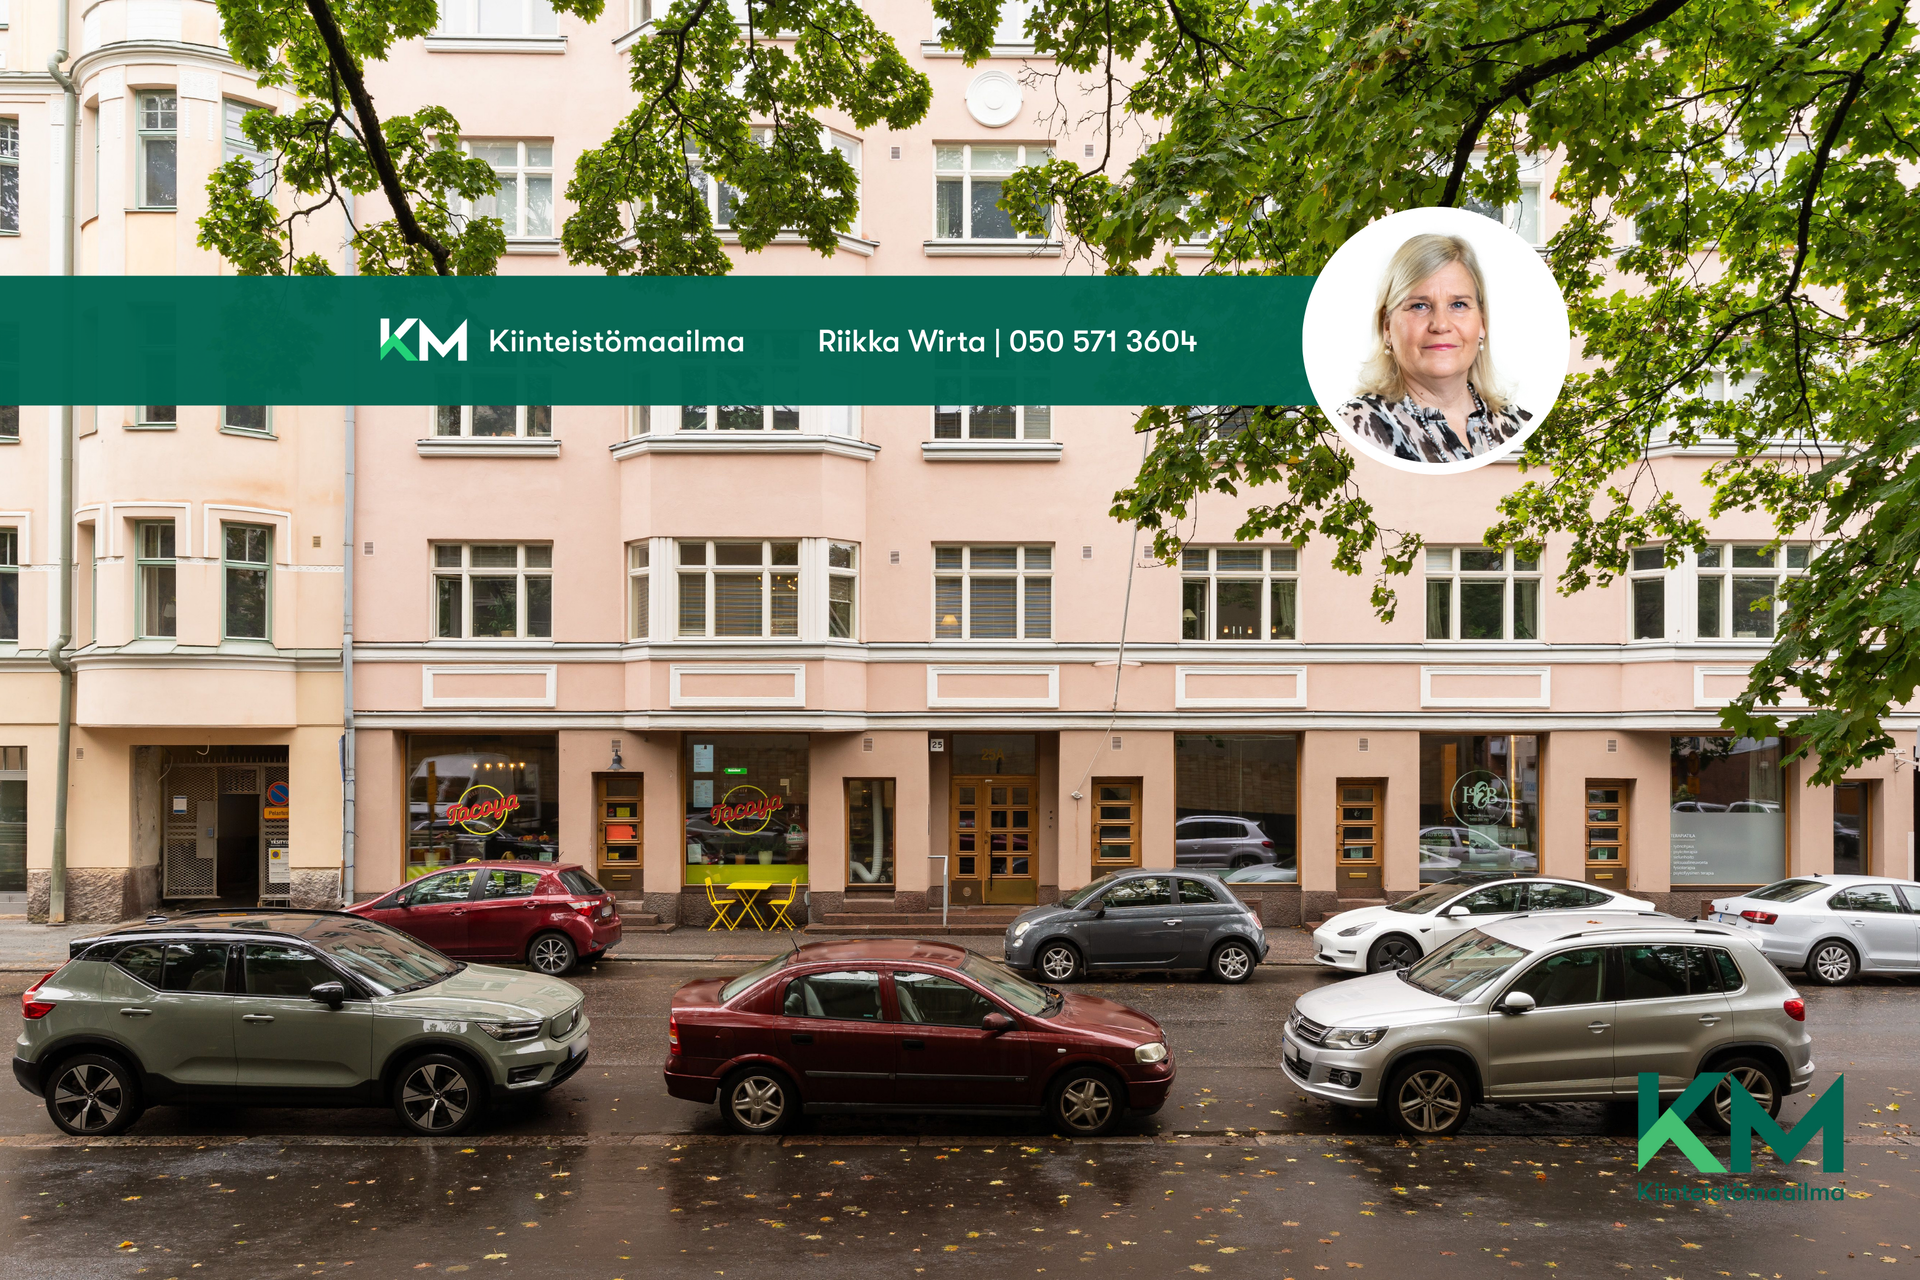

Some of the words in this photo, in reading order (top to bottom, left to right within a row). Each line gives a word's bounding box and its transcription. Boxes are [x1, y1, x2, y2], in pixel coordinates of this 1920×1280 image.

[931, 740, 943, 749] 25
[981, 748, 1005, 760] 25A
[446, 794, 520, 826] Tacoya
[710, 795, 784, 826] Tacoya
